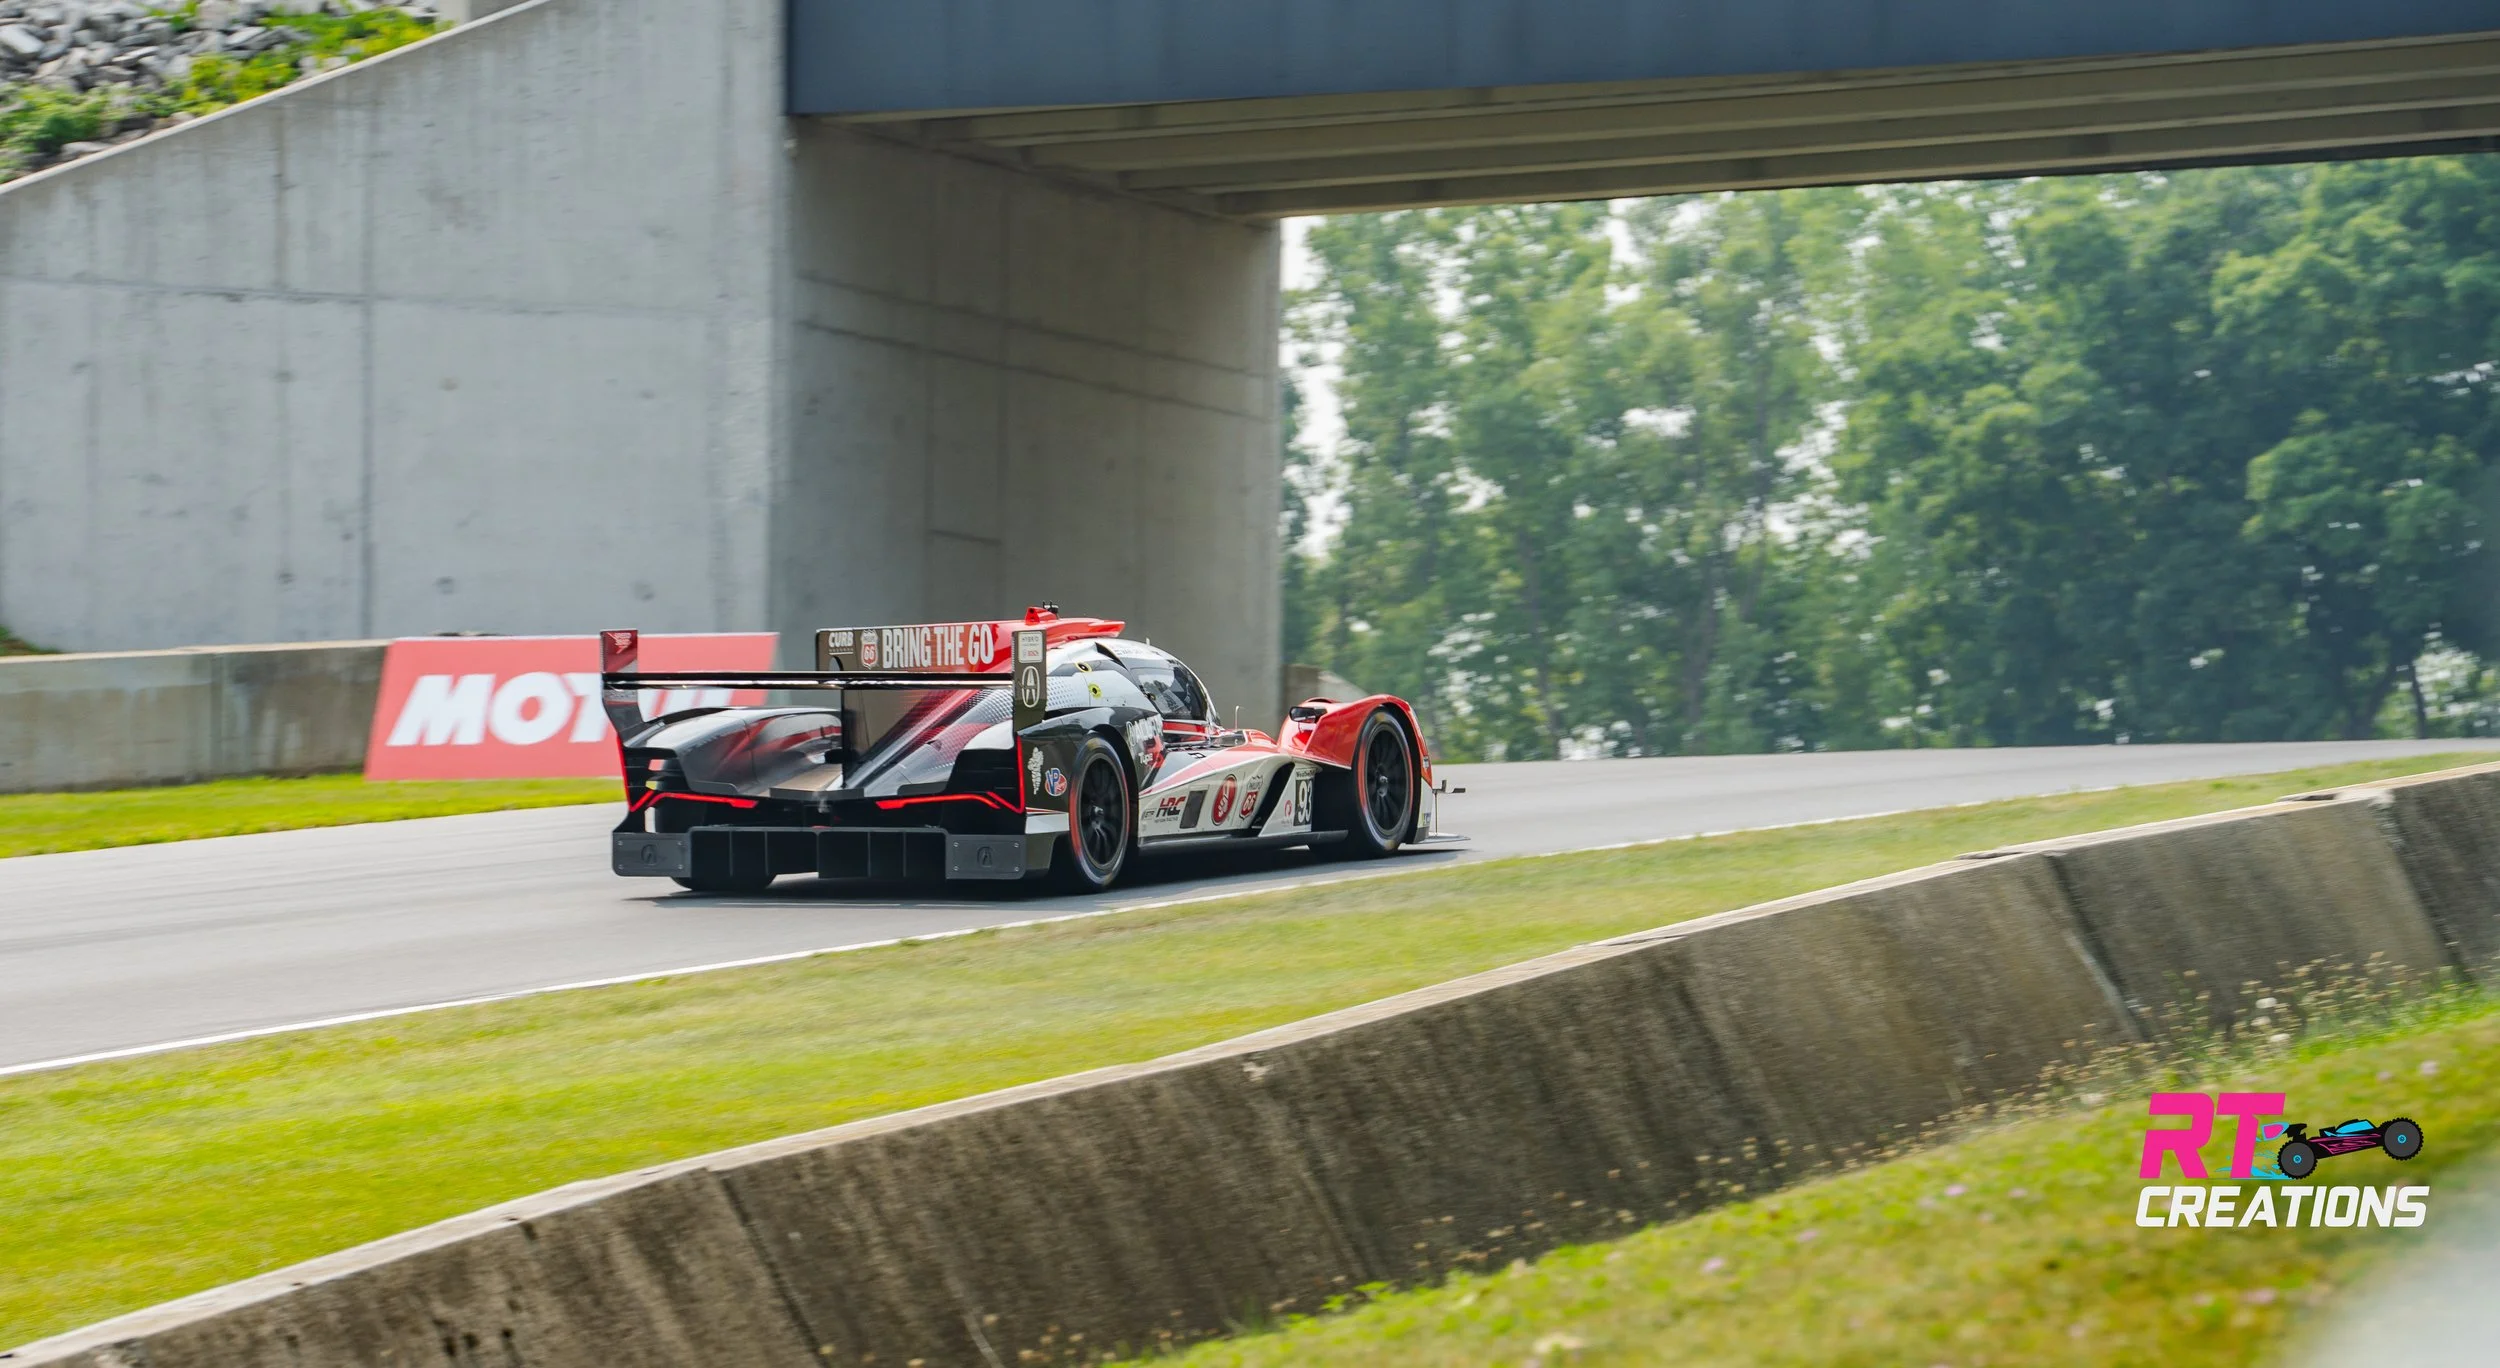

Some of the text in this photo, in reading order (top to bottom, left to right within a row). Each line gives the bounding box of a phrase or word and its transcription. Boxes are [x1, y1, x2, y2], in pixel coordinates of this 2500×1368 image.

[829, 631, 854, 648] CURB
[882, 623, 994, 669] BRING THE GO
[864, 645, 876, 661] 66
[1156, 795, 1187, 818] HRC
[1242, 793, 1257, 812] 66
[1298, 780, 1313, 823] 93
